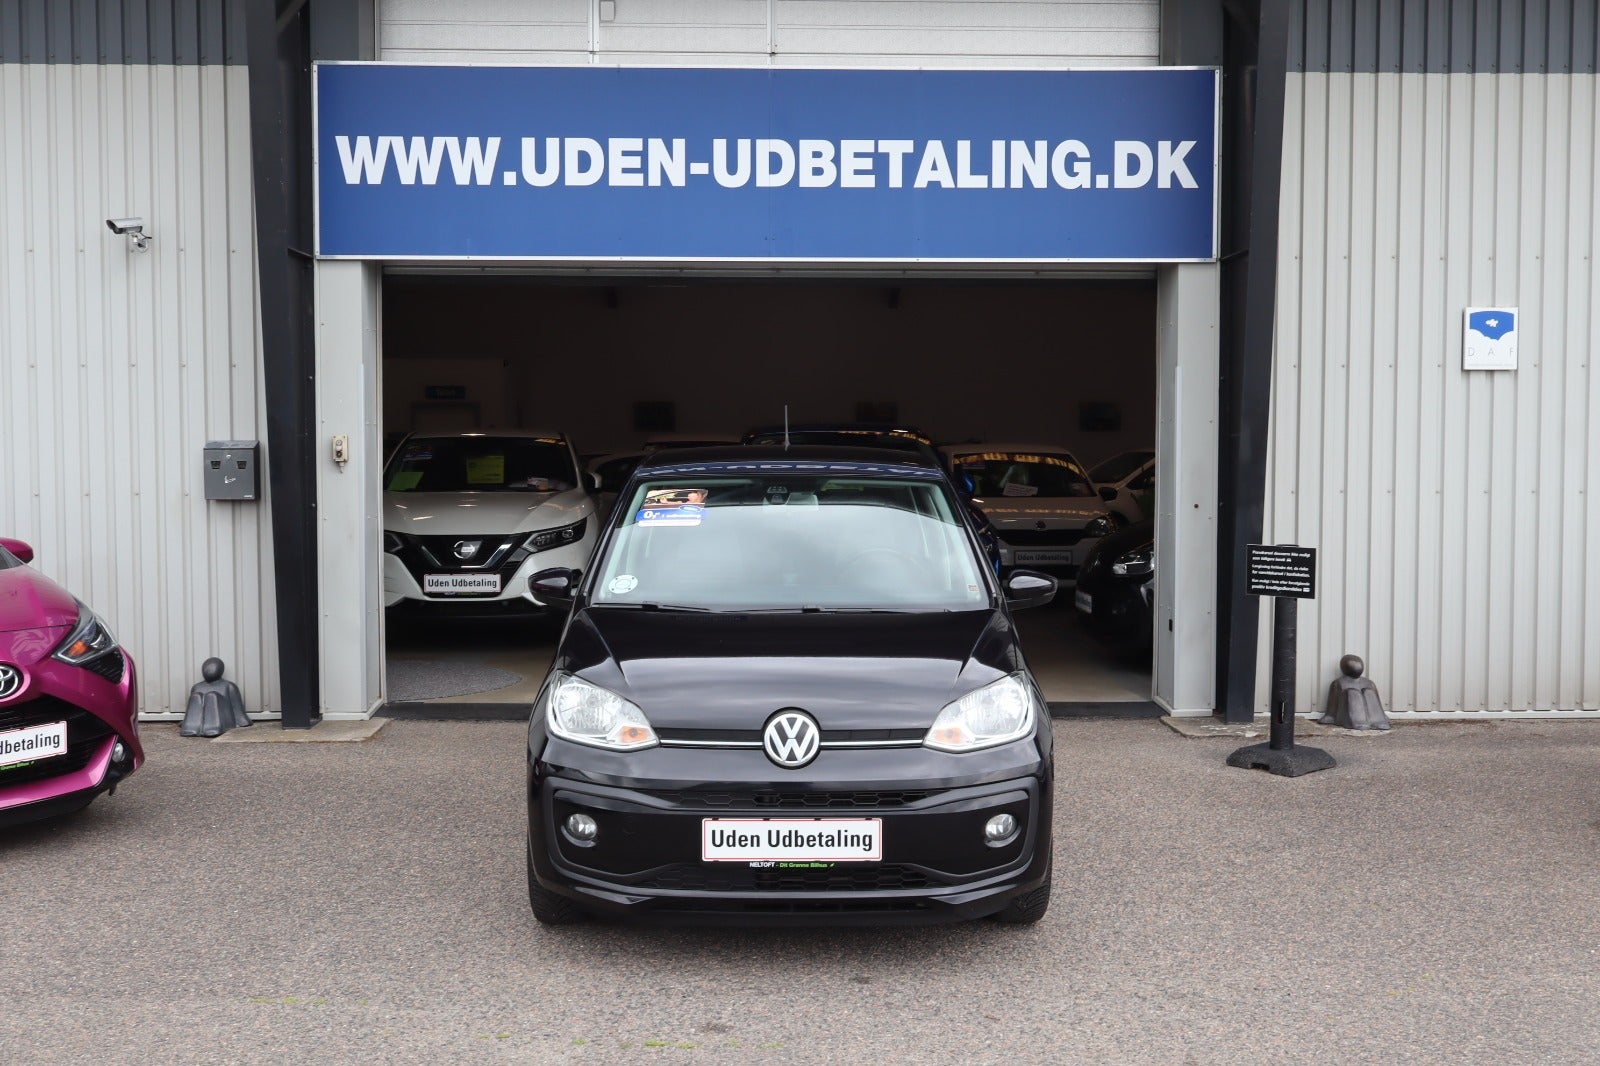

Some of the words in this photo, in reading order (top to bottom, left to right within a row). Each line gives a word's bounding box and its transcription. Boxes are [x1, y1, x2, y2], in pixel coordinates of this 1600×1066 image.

[335, 135, 1199, 190] WWW.UDEN-UDBETALING.DK
[427, 578, 449, 588] Uden
[451, 578, 497, 589] Udbetaling
[711, 829, 761, 848] Uden
[767, 829, 873, 852] Udbetaling
